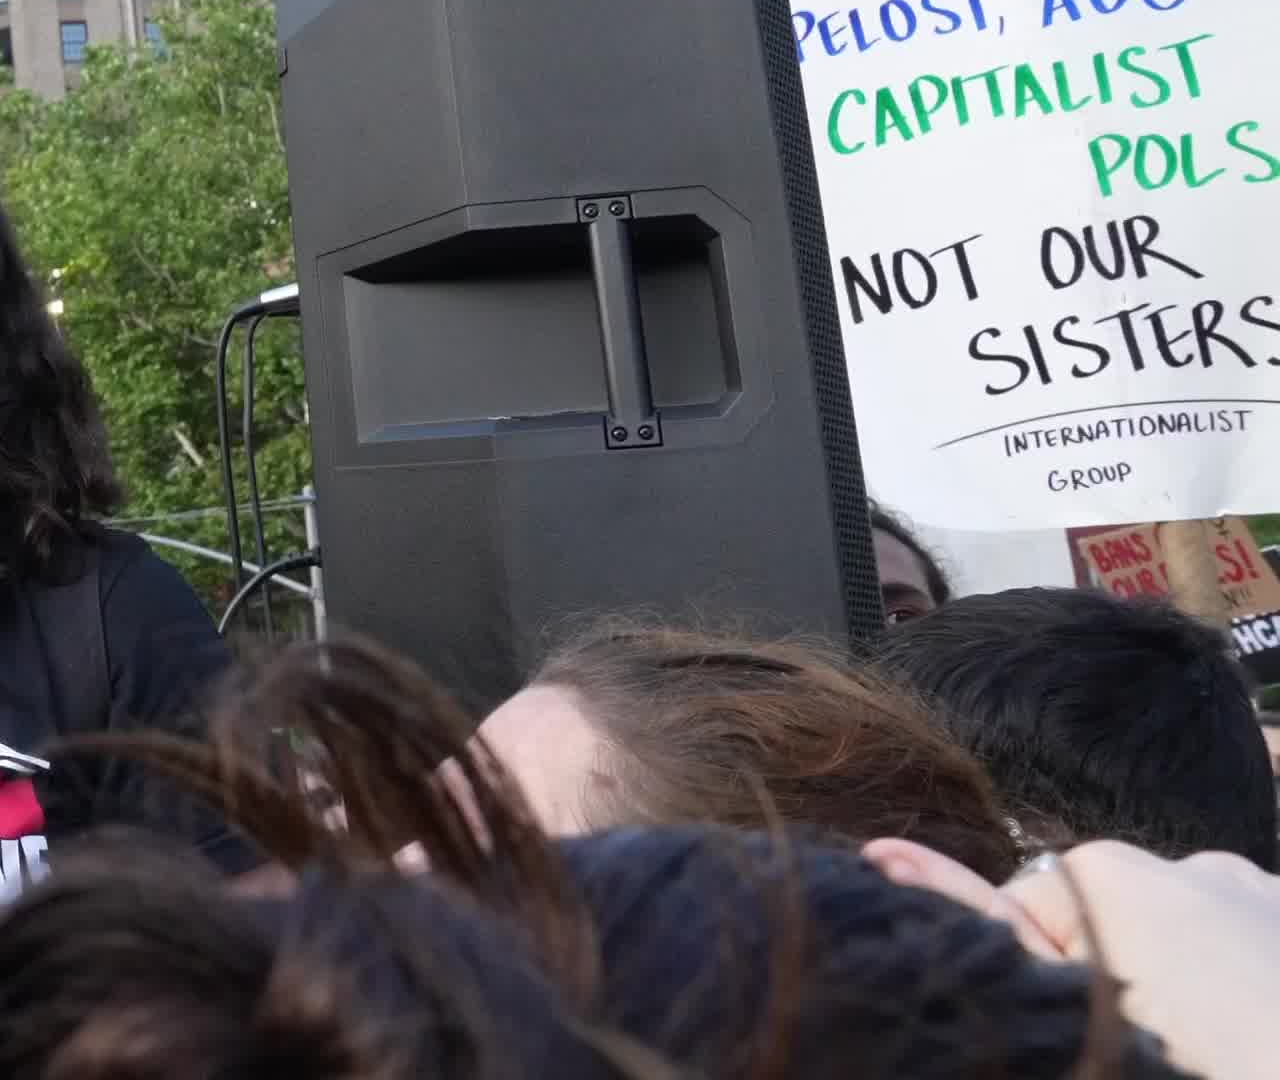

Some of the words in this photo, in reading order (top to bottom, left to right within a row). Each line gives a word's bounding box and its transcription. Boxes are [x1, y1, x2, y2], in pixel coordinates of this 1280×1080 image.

[826, 33, 1215, 155] CAPITALIST
[1087, 119, 1280, 198] POLS
[839, 233, 985, 324] NOT
[1040, 214, 1207, 290] OUR
[968, 295, 1280, 396] SISTERS
[1003, 409, 1254, 457] INTERNATIONALIST
[1047, 461, 1132, 492] GROUP
[1087, 531, 1153, 574] BANS
